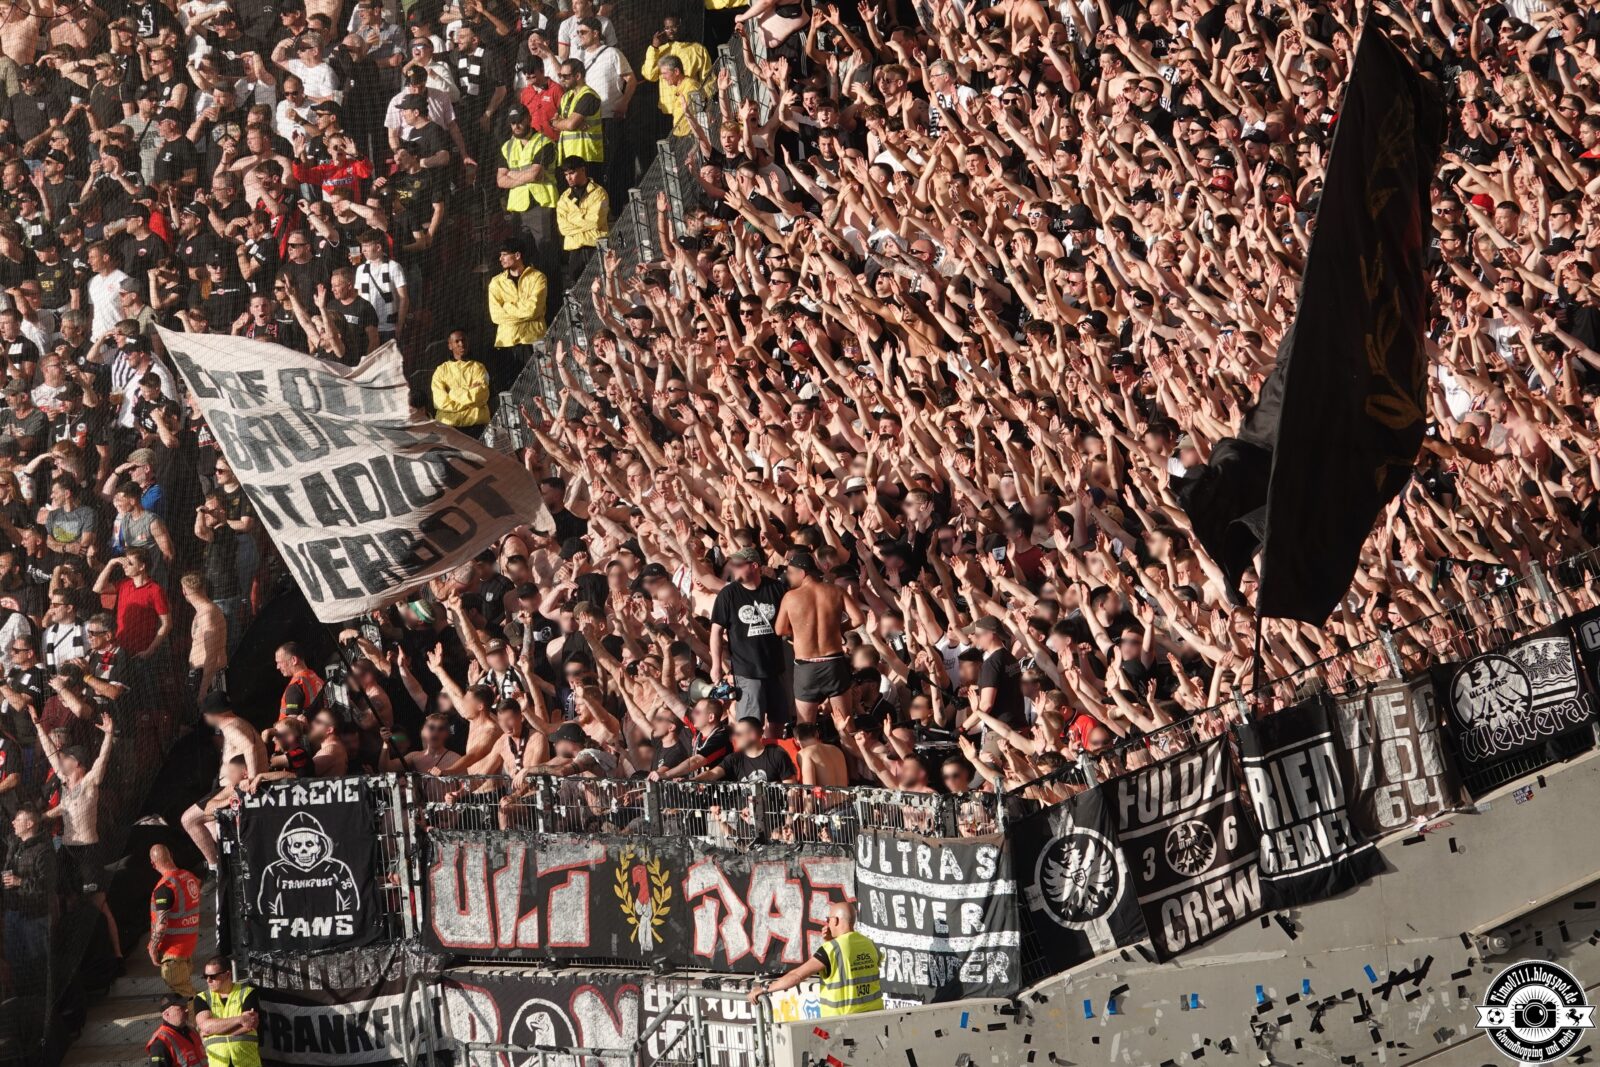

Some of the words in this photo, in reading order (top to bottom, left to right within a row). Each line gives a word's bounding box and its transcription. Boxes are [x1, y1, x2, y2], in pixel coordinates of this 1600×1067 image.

[209, 406, 442, 474] GRUP
[282, 474, 516, 603] VERBOT
[1468, 676, 1508, 700] ULTRAS
[243, 777, 360, 809] EXTREME
[1116, 739, 1226, 831] FULDA
[1243, 741, 1346, 831] RIED
[1374, 777, 1446, 828] 64
[857, 834, 1000, 881] ULTRAS
[1142, 846, 1156, 882] 3
[1223, 815, 1238, 851] 6
[281, 877, 336, 889] FRANKFURT
[268, 914, 354, 939] FANS
[868, 889, 986, 935] NEVER
[1160, 864, 1262, 953] CREW
[879, 946, 1010, 987] RRENDER
